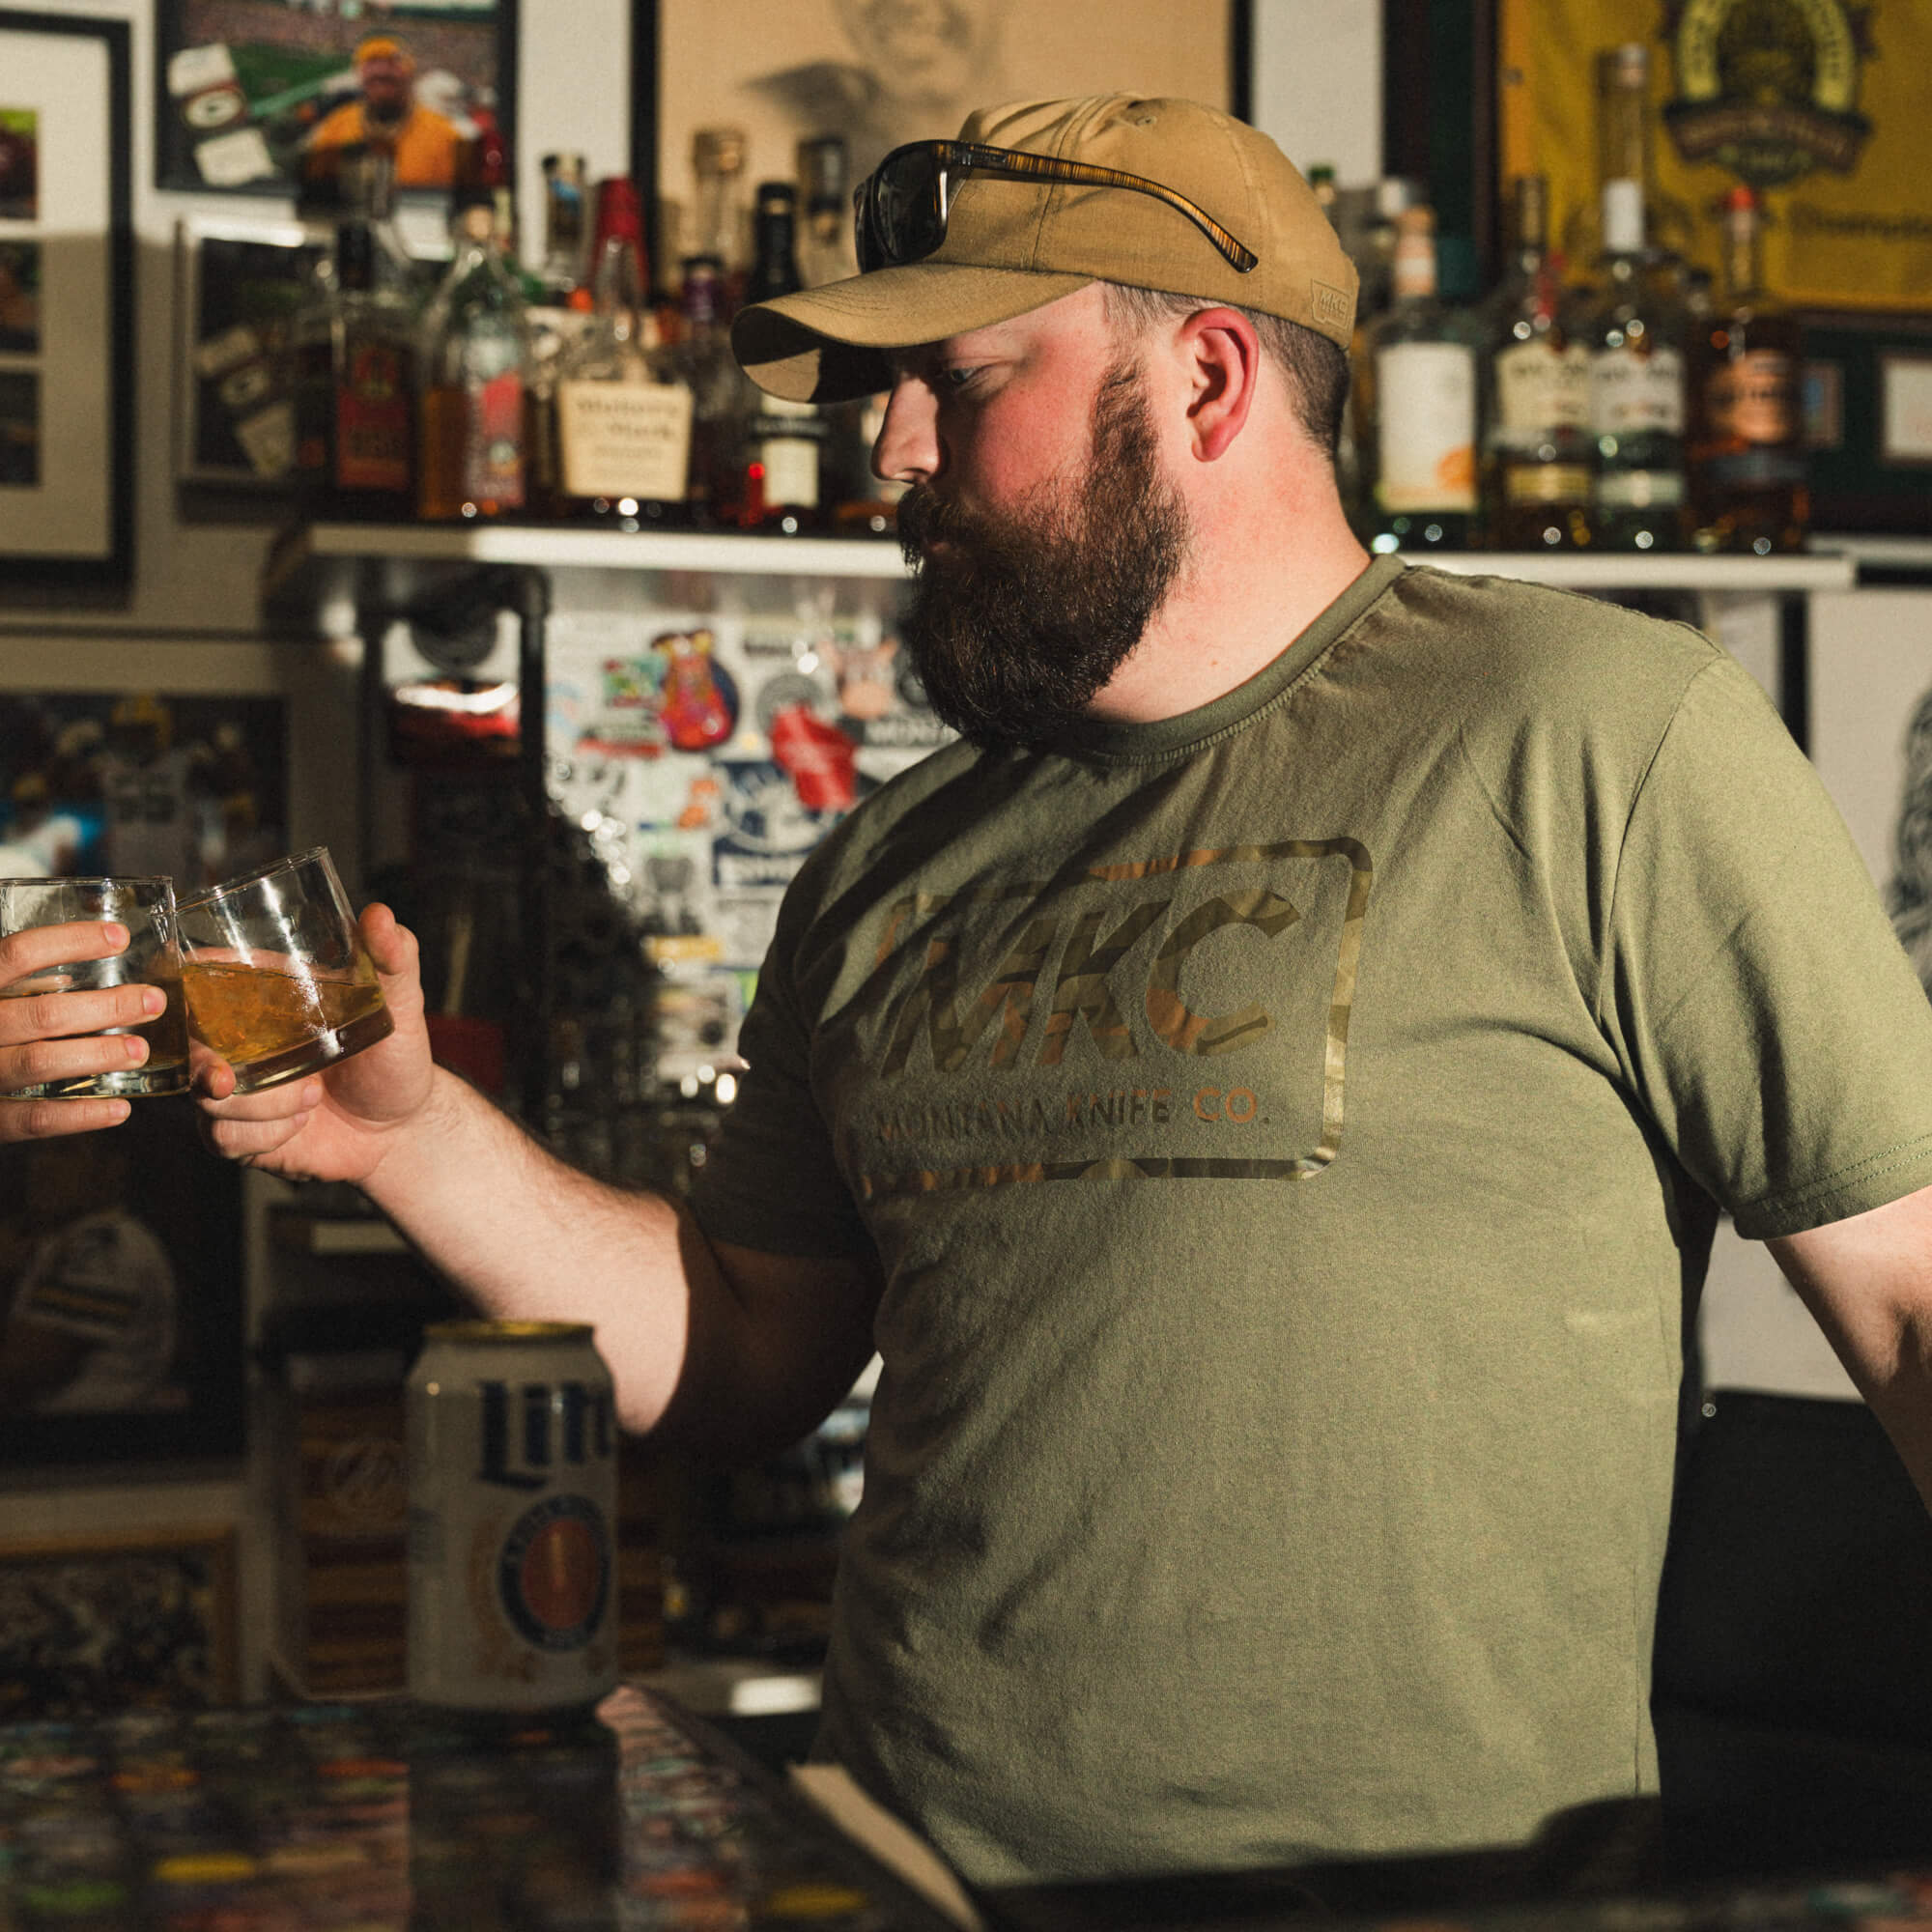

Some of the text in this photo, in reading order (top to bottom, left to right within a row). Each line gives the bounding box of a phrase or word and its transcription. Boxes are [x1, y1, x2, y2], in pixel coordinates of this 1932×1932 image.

[1319, 289, 1347, 316] MKC
[877, 889, 1302, 1074] MKC
[873, 1085, 1270, 1143] MONTANA KNIFE CO.
